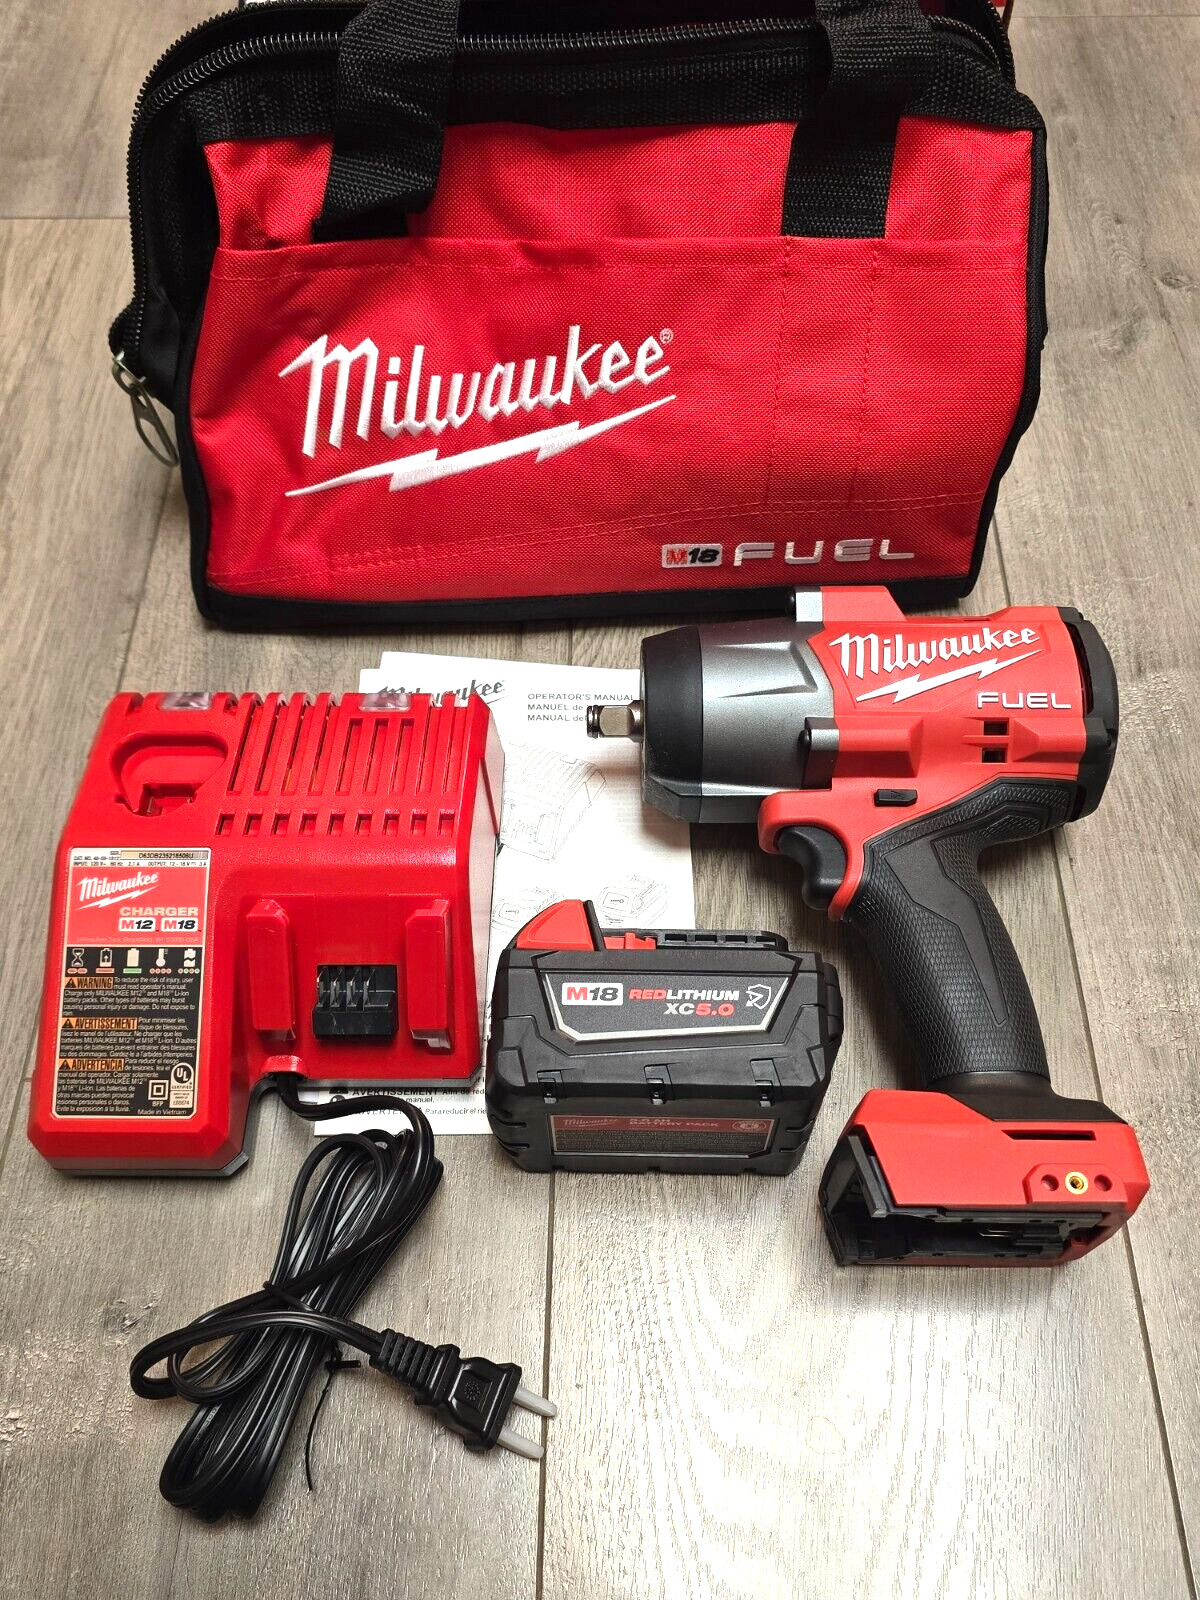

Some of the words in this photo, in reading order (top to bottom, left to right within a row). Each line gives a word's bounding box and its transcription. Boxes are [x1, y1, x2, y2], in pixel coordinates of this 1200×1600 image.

[666, 547, 720, 564] M18
[733, 538, 915, 567] FUEL
[829, 627, 1041, 679] Milwaukee
[527, 693, 591, 701] OPERATOR'S
[594, 694, 634, 702] MANUAL
[977, 692, 1072, 709] FUEL
[527, 703, 569, 711] MANUEL
[527, 714, 570, 722] MANUAL
[76, 872, 160, 902] Milwaukee
[119, 906, 199, 917] CHARGER
[121, 919, 154, 930] M12
[163, 919, 196, 930] M18
[77, 977, 112, 989] WARNING
[566, 986, 619, 1001] M18
[628, 988, 740, 1001] REDLITHIUM
[663, 1002, 735, 1017] XC5.0
[75, 1018, 137, 1029] AVERTISSEMENT
[72, 1059, 122, 1070] ADVERTENCIA
